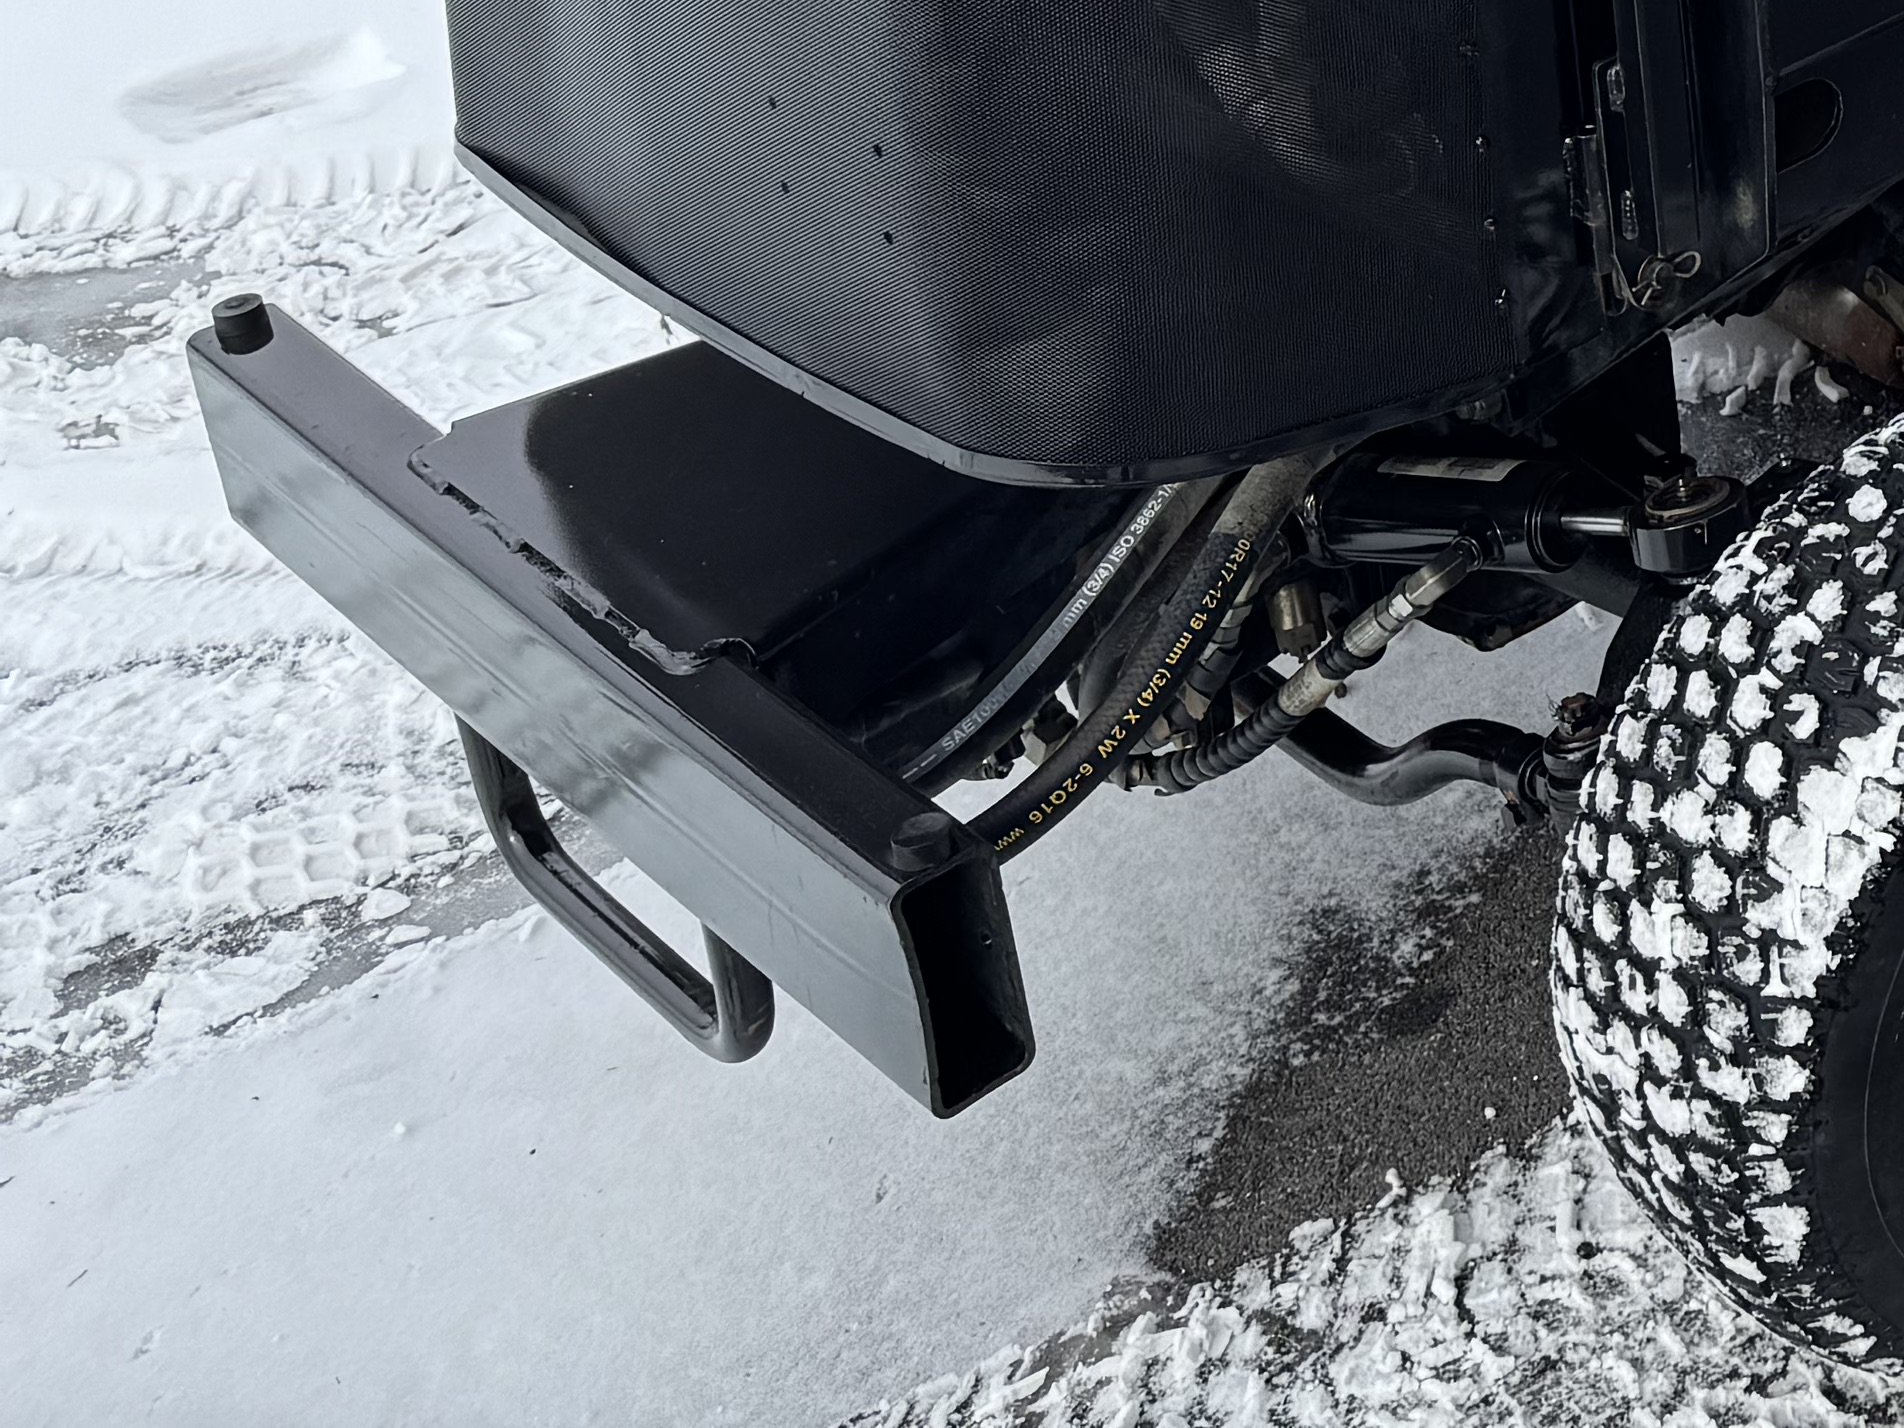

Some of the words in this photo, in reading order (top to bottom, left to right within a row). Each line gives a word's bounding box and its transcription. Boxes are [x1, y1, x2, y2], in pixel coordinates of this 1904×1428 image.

[1083, 562, 1115, 597] (3/4)
[1108, 535, 1136, 563] ISO
[1130, 482, 1177, 536] 3862-1/
[1189, 611, 1208, 631] 19
[1165, 631, 1193, 665] mm
[1136, 667, 1172, 707] (3/4)
[1028, 762, 1094, 824] 6-2Q16
